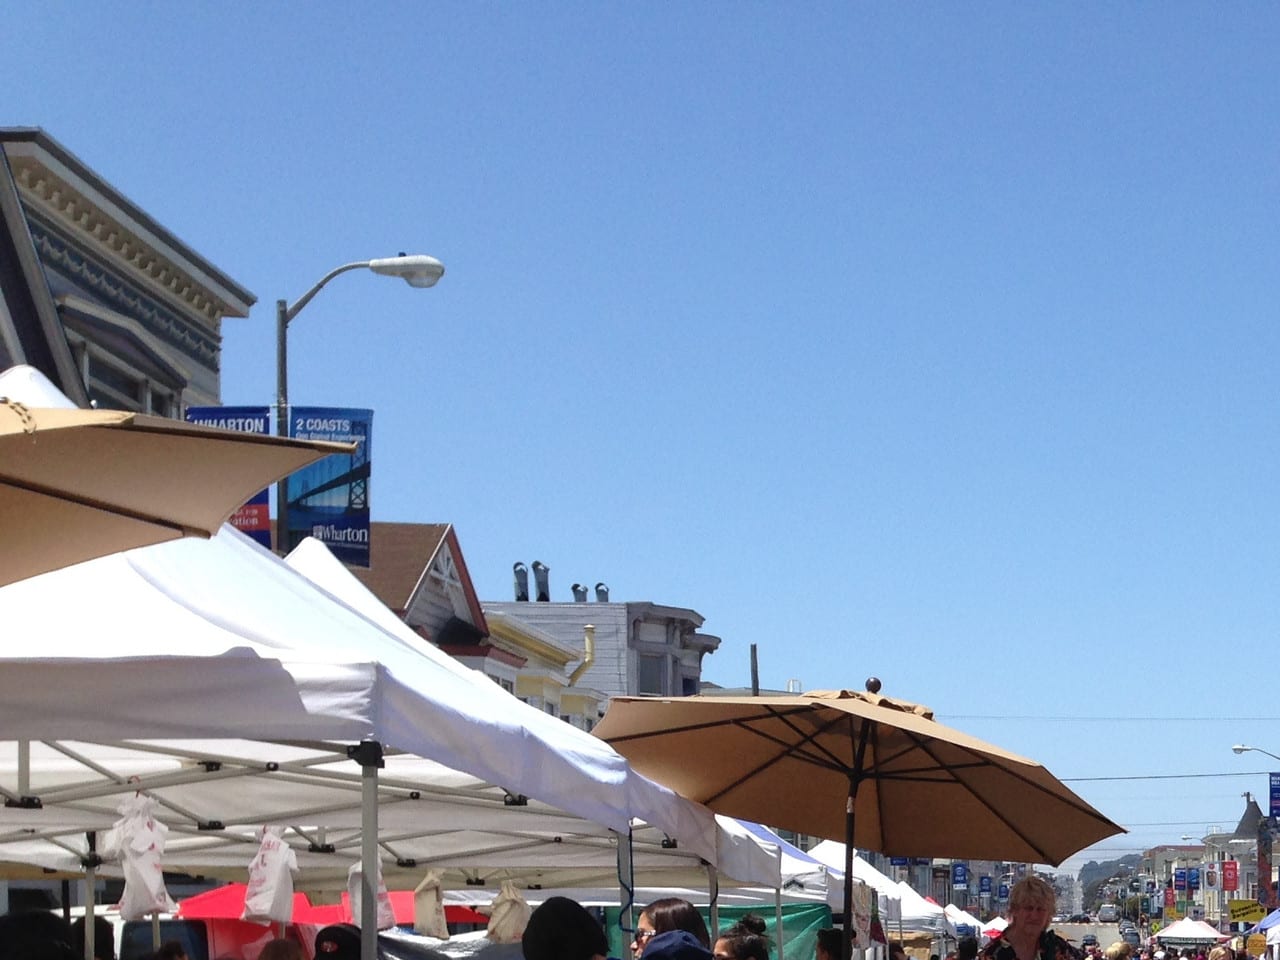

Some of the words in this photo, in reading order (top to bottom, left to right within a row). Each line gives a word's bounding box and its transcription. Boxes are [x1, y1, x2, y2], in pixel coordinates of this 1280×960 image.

[194, 418, 264, 432] WHARTON
[296, 418, 304, 431] 2
[306, 418, 350, 432] COASTS
[323, 524, 368, 542] Wharton
